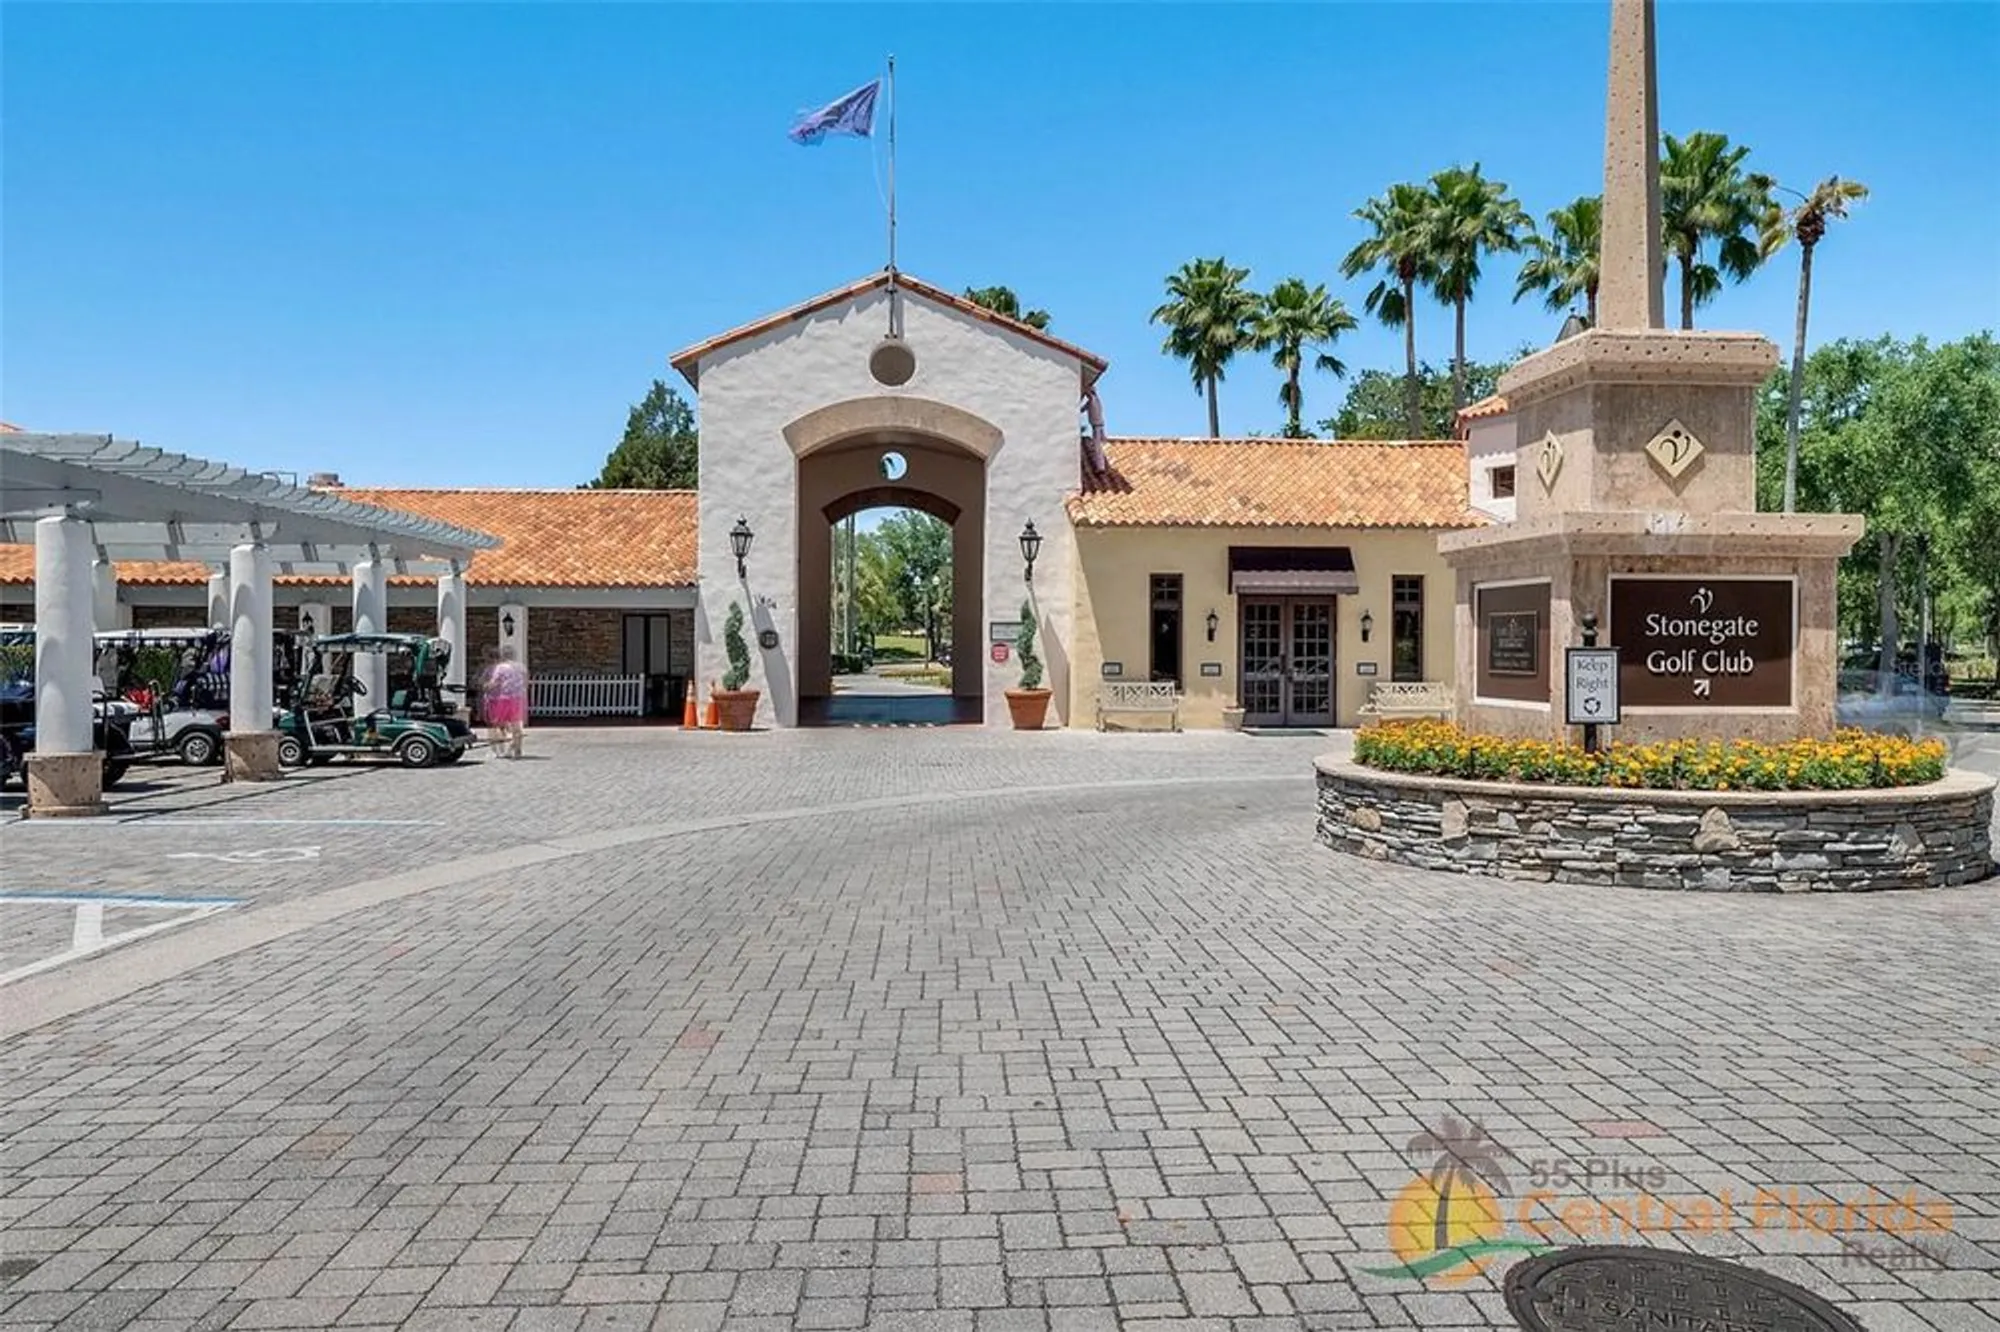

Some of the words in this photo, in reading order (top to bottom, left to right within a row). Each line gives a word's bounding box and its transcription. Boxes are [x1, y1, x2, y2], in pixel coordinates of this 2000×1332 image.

[1645, 614, 1759, 645] Stonegate
[1576, 657, 1608, 673] Keep
[1646, 648, 1697, 673] Golf
[1702, 649, 1754, 673] Club
[1576, 676, 1609, 693] Right
